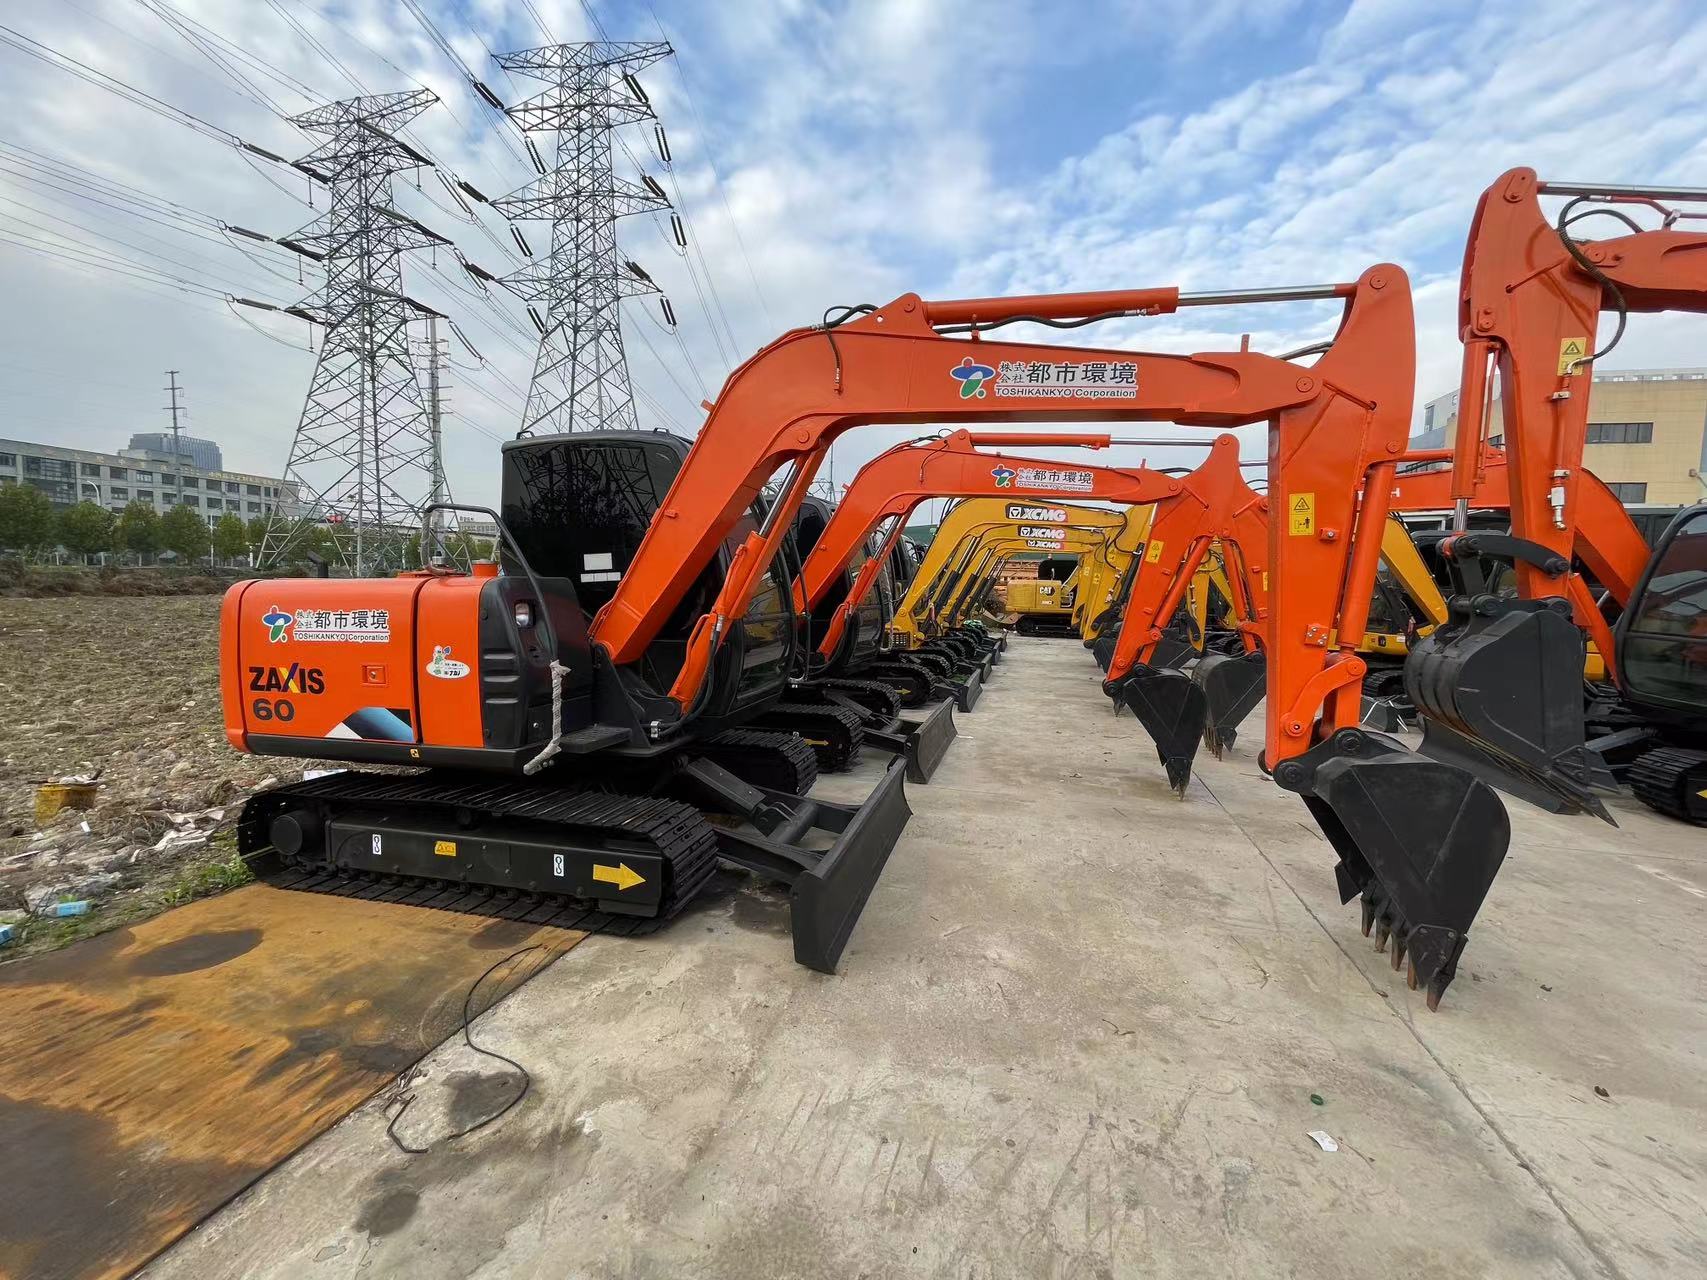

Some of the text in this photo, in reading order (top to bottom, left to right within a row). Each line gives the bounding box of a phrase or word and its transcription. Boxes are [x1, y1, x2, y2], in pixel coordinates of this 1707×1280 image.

[1026, 362, 1136, 384] 都市環境
[996, 388, 1136, 398] TOSHIKANKYO Corporation
[1021, 508, 1067, 522] XCMG
[1030, 528, 1065, 539] XCMG
[1039, 586, 1052, 595] CAT
[314, 610, 388, 630] 都市環境
[294, 632, 389, 642] TOSHIKANKYO Corporation
[248, 662, 325, 694] ZAXIS
[253, 698, 295, 722] 60
